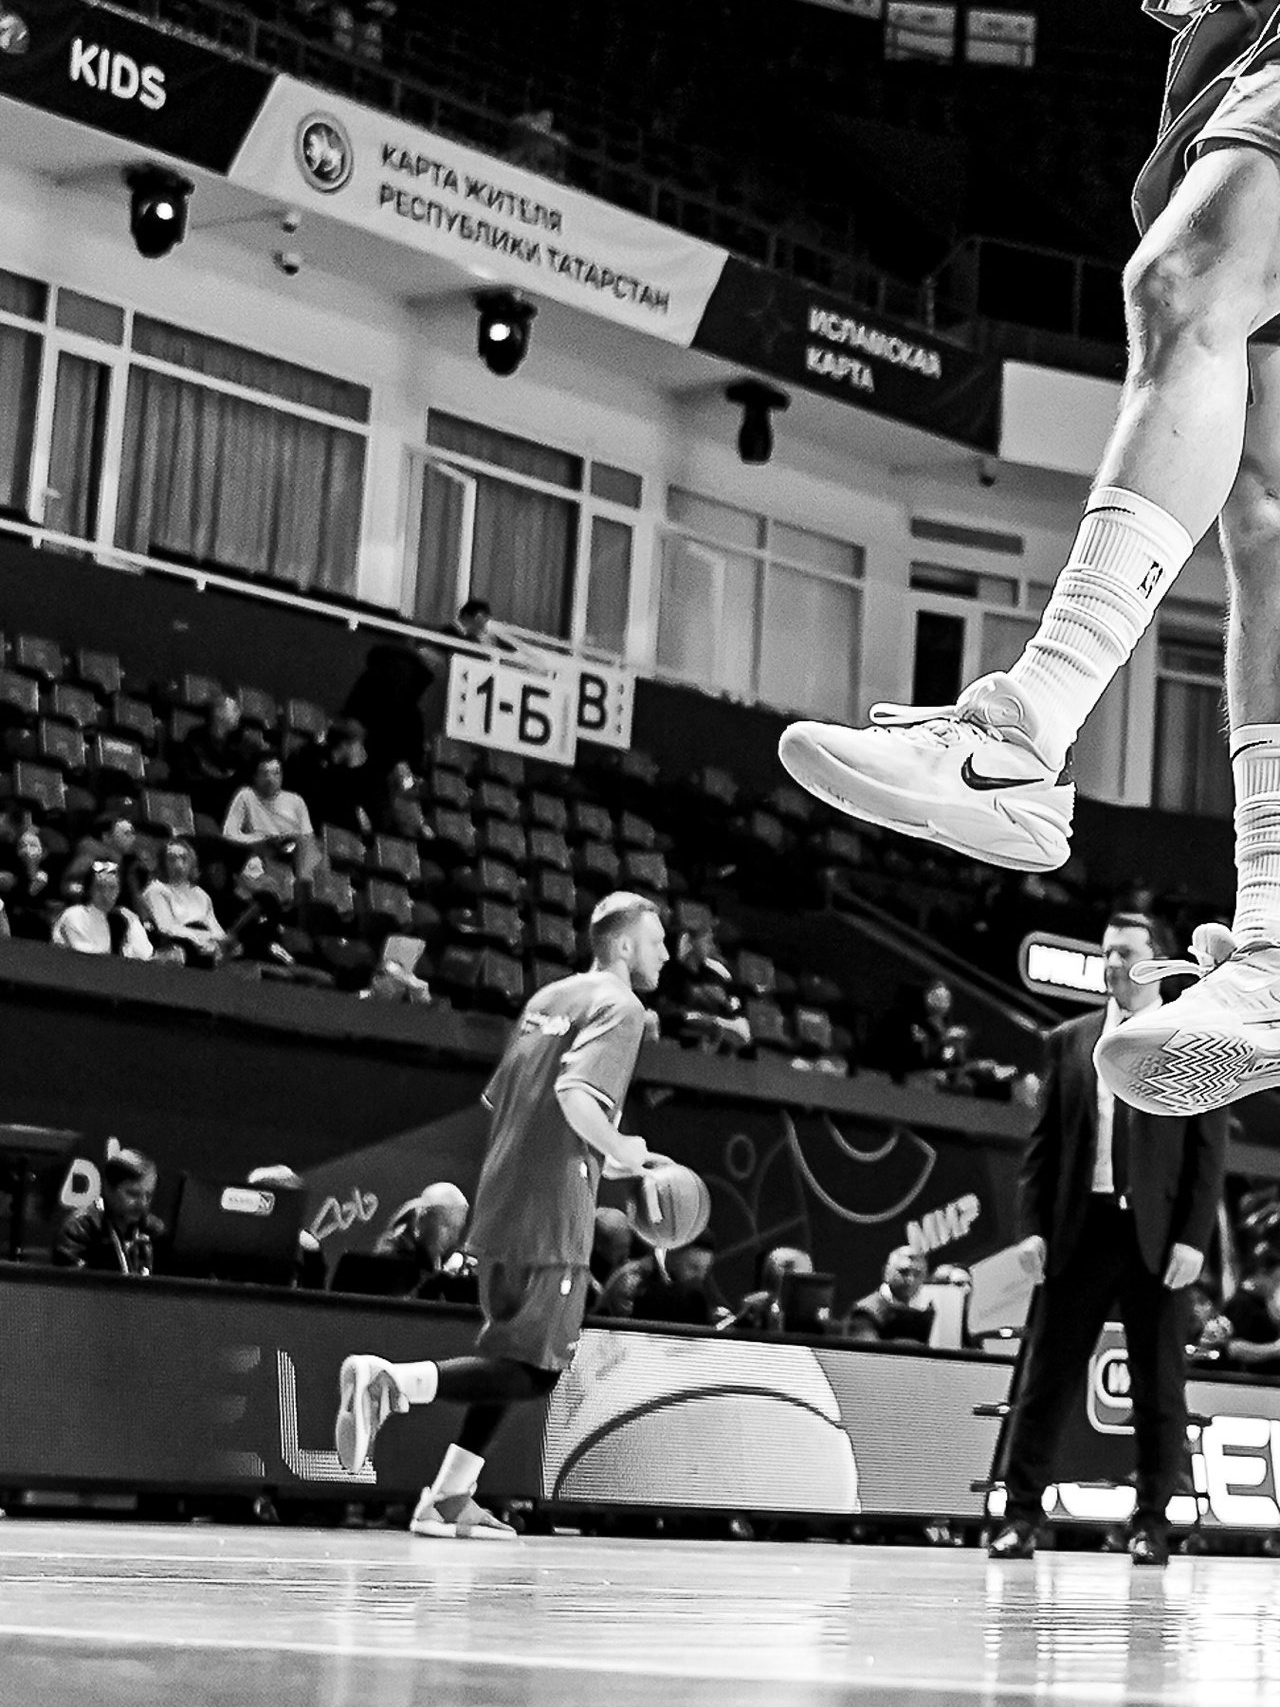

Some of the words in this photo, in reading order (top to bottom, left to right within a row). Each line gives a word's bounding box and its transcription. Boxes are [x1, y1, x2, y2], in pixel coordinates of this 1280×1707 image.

[69, 38, 166, 110] KIDS
[381, 143, 459, 193] КАРТА
[464, 174, 563, 235] ЖИТЕЛЯ
[380, 182, 542, 266] РЕСПУБЛИКИ
[548, 247, 670, 314] ТАТАРСТАН
[476, 675, 550, 746] 1-Б
